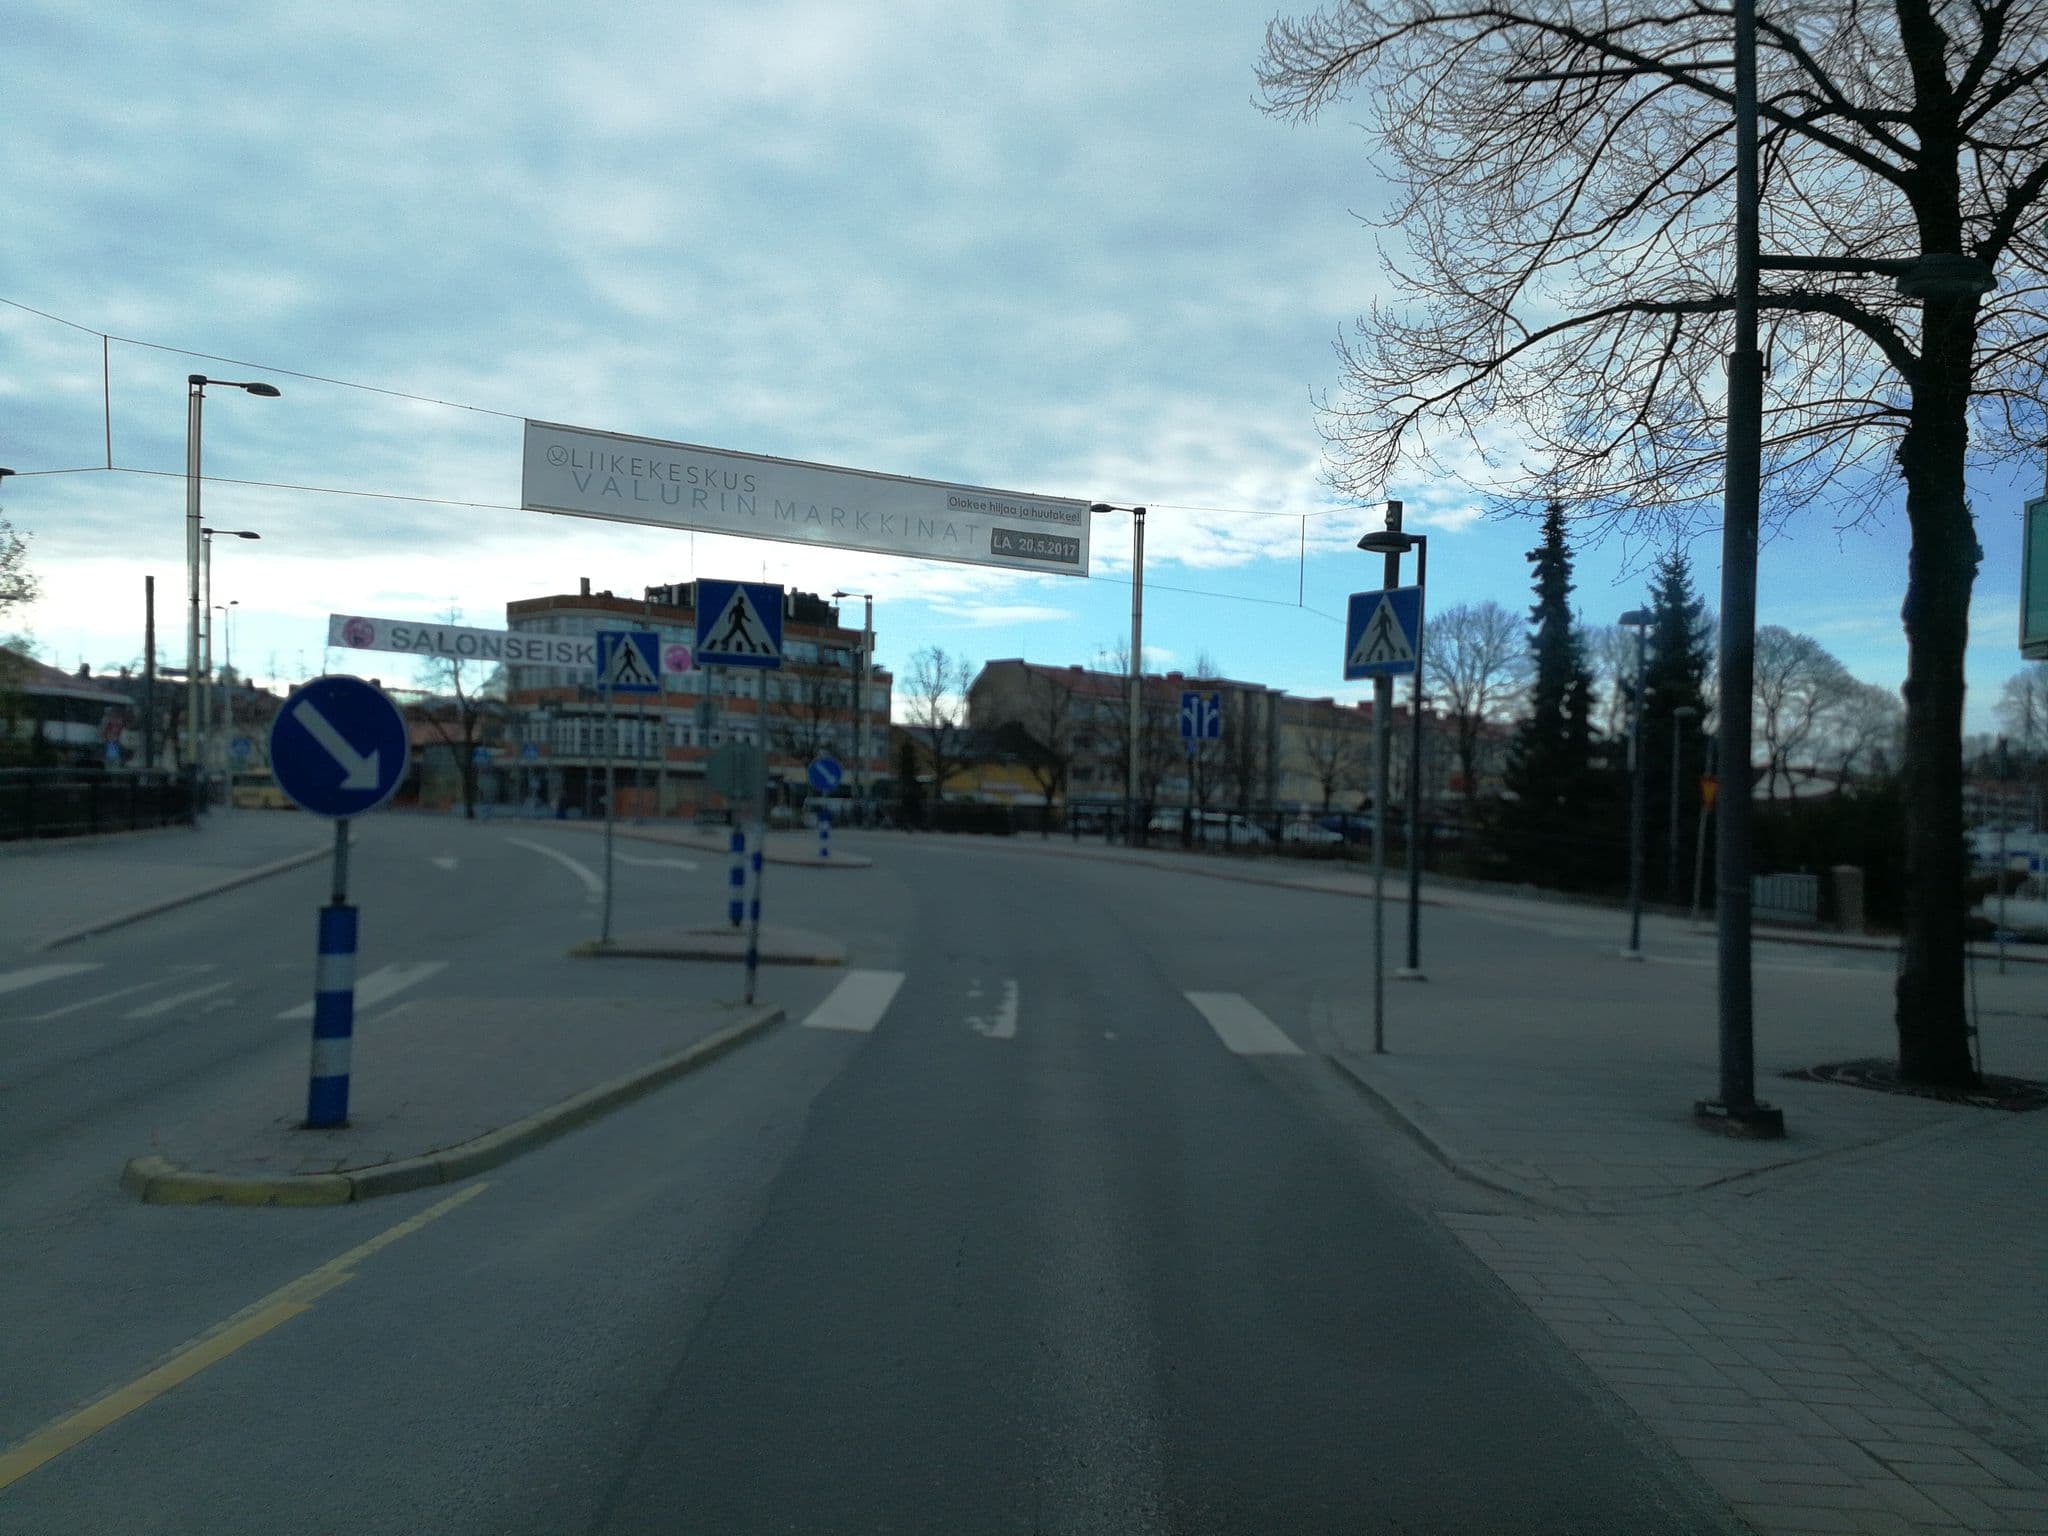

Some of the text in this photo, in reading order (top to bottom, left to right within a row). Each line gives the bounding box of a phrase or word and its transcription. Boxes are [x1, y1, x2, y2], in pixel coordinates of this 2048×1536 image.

[571, 448, 756, 493] LIIKEKESKUS
[571, 470, 980, 545] VALURIN MARKKINAT
[1019, 507, 1029, 517] ja
[993, 535, 1077, 557] LA 20.5.2017
[391, 627, 598, 665] SALONSEISK
